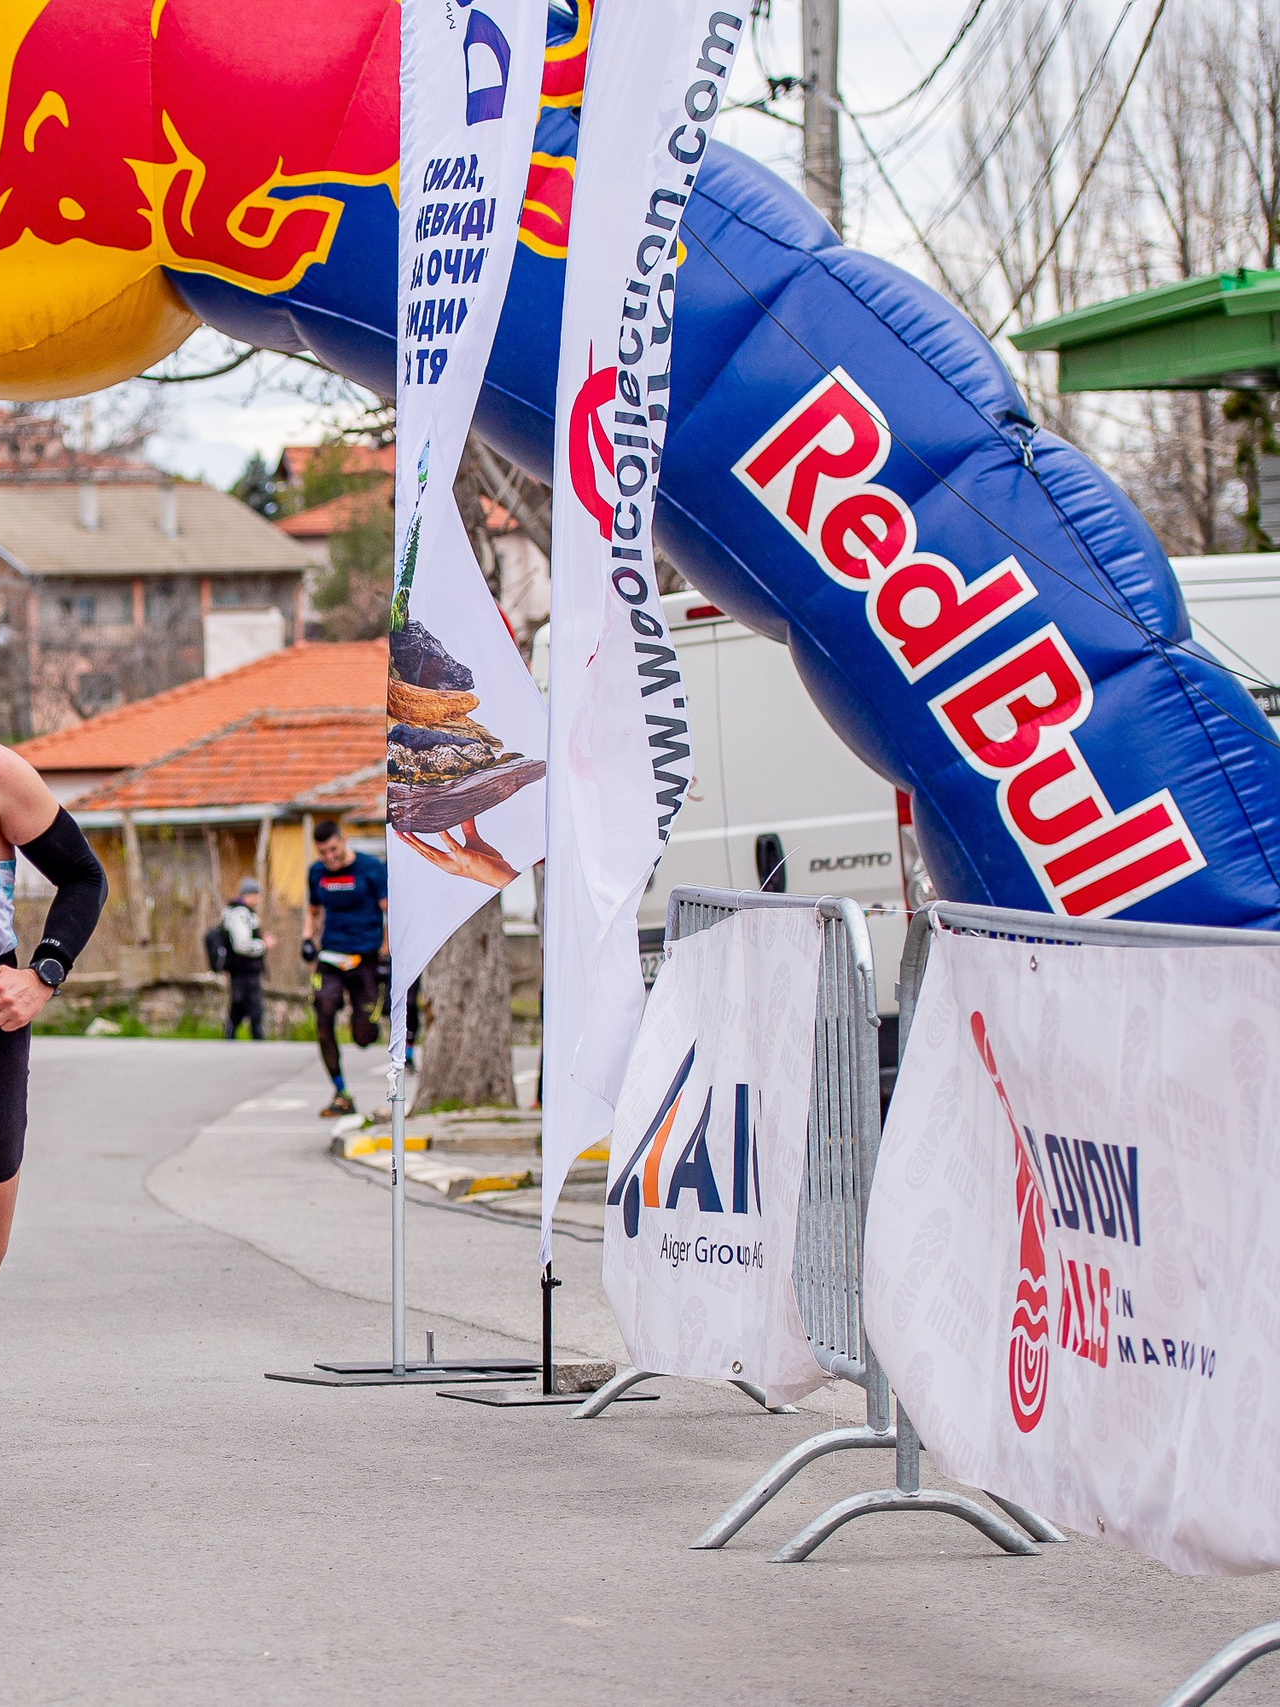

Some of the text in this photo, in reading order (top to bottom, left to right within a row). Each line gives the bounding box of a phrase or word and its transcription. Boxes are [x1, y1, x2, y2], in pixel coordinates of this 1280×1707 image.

[736, 370, 1202, 918] Red Bull
[809, 852, 892, 874] DUCATO
[659, 1233, 764, 1273] Aiger Group AG
[1116, 1286, 1135, 1319] IN
